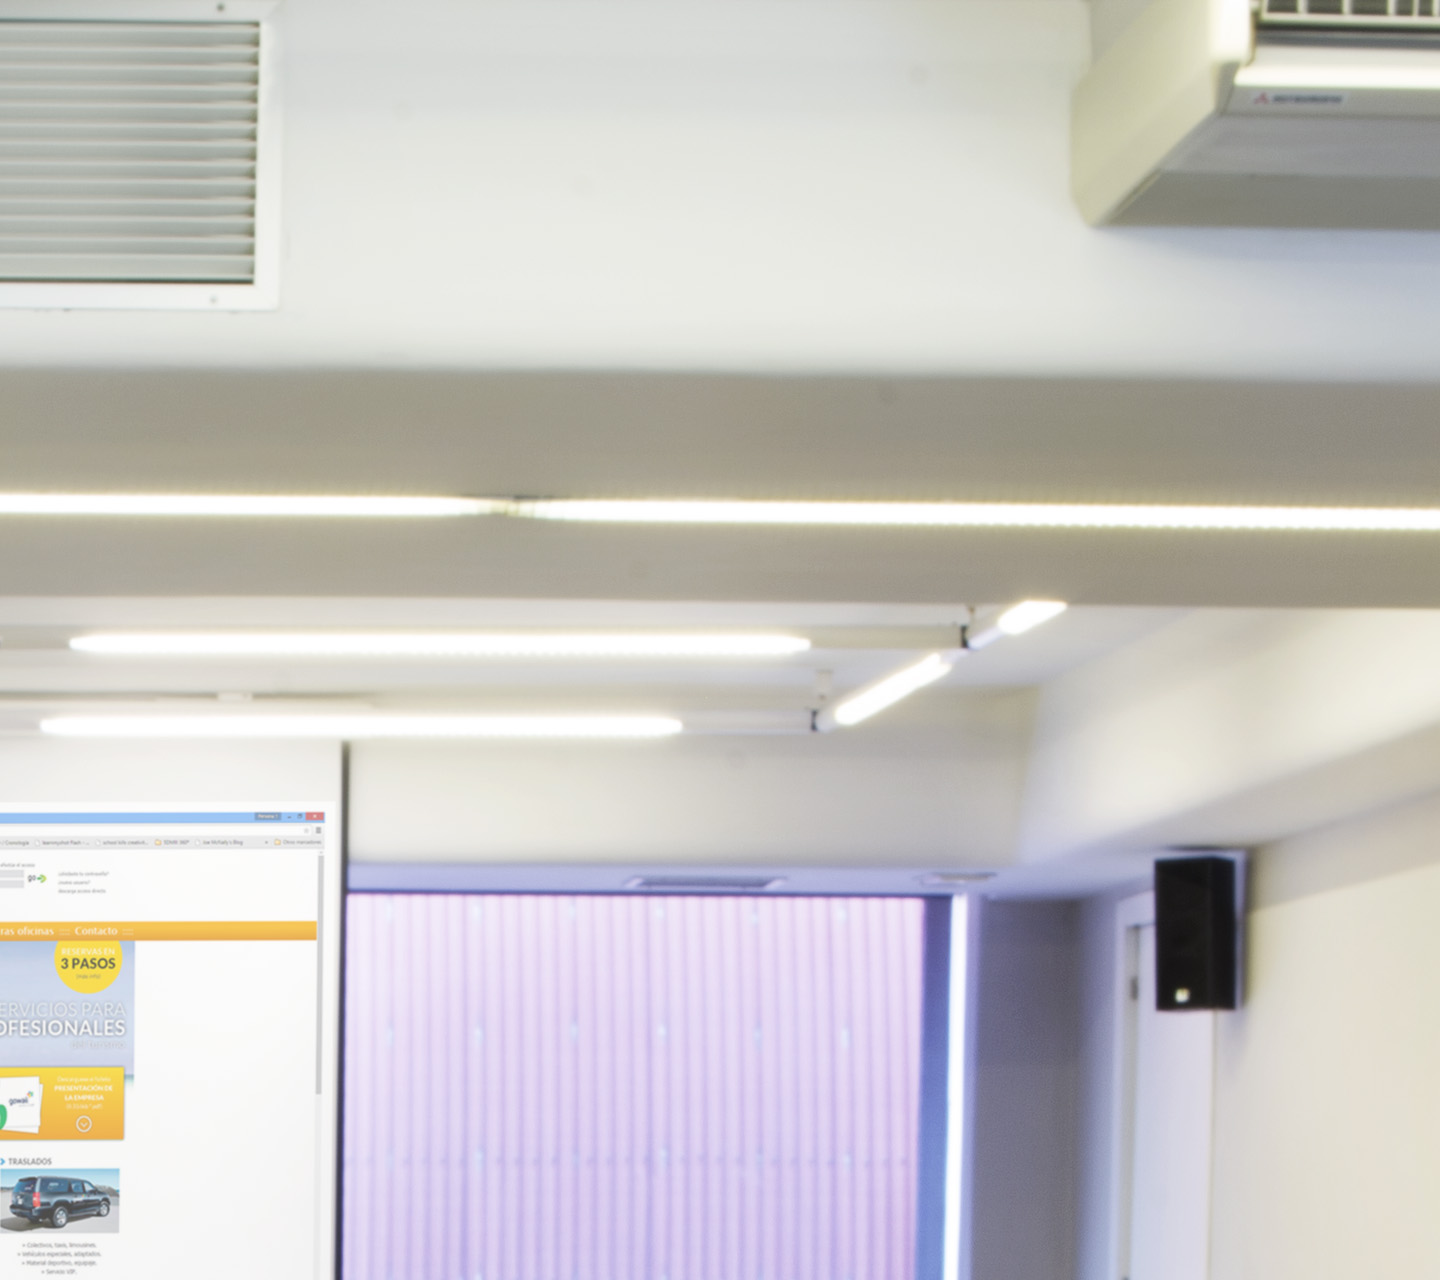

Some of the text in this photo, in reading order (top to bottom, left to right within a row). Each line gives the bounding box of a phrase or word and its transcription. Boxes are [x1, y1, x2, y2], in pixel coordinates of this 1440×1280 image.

[17, 926, 54, 936] oficinas
[74, 926, 118, 935] Contacto
[61, 948, 103, 956] RESERVAS
[61, 958, 116, 969] 3 PASOS
[82, 1002, 127, 1017] PARA
